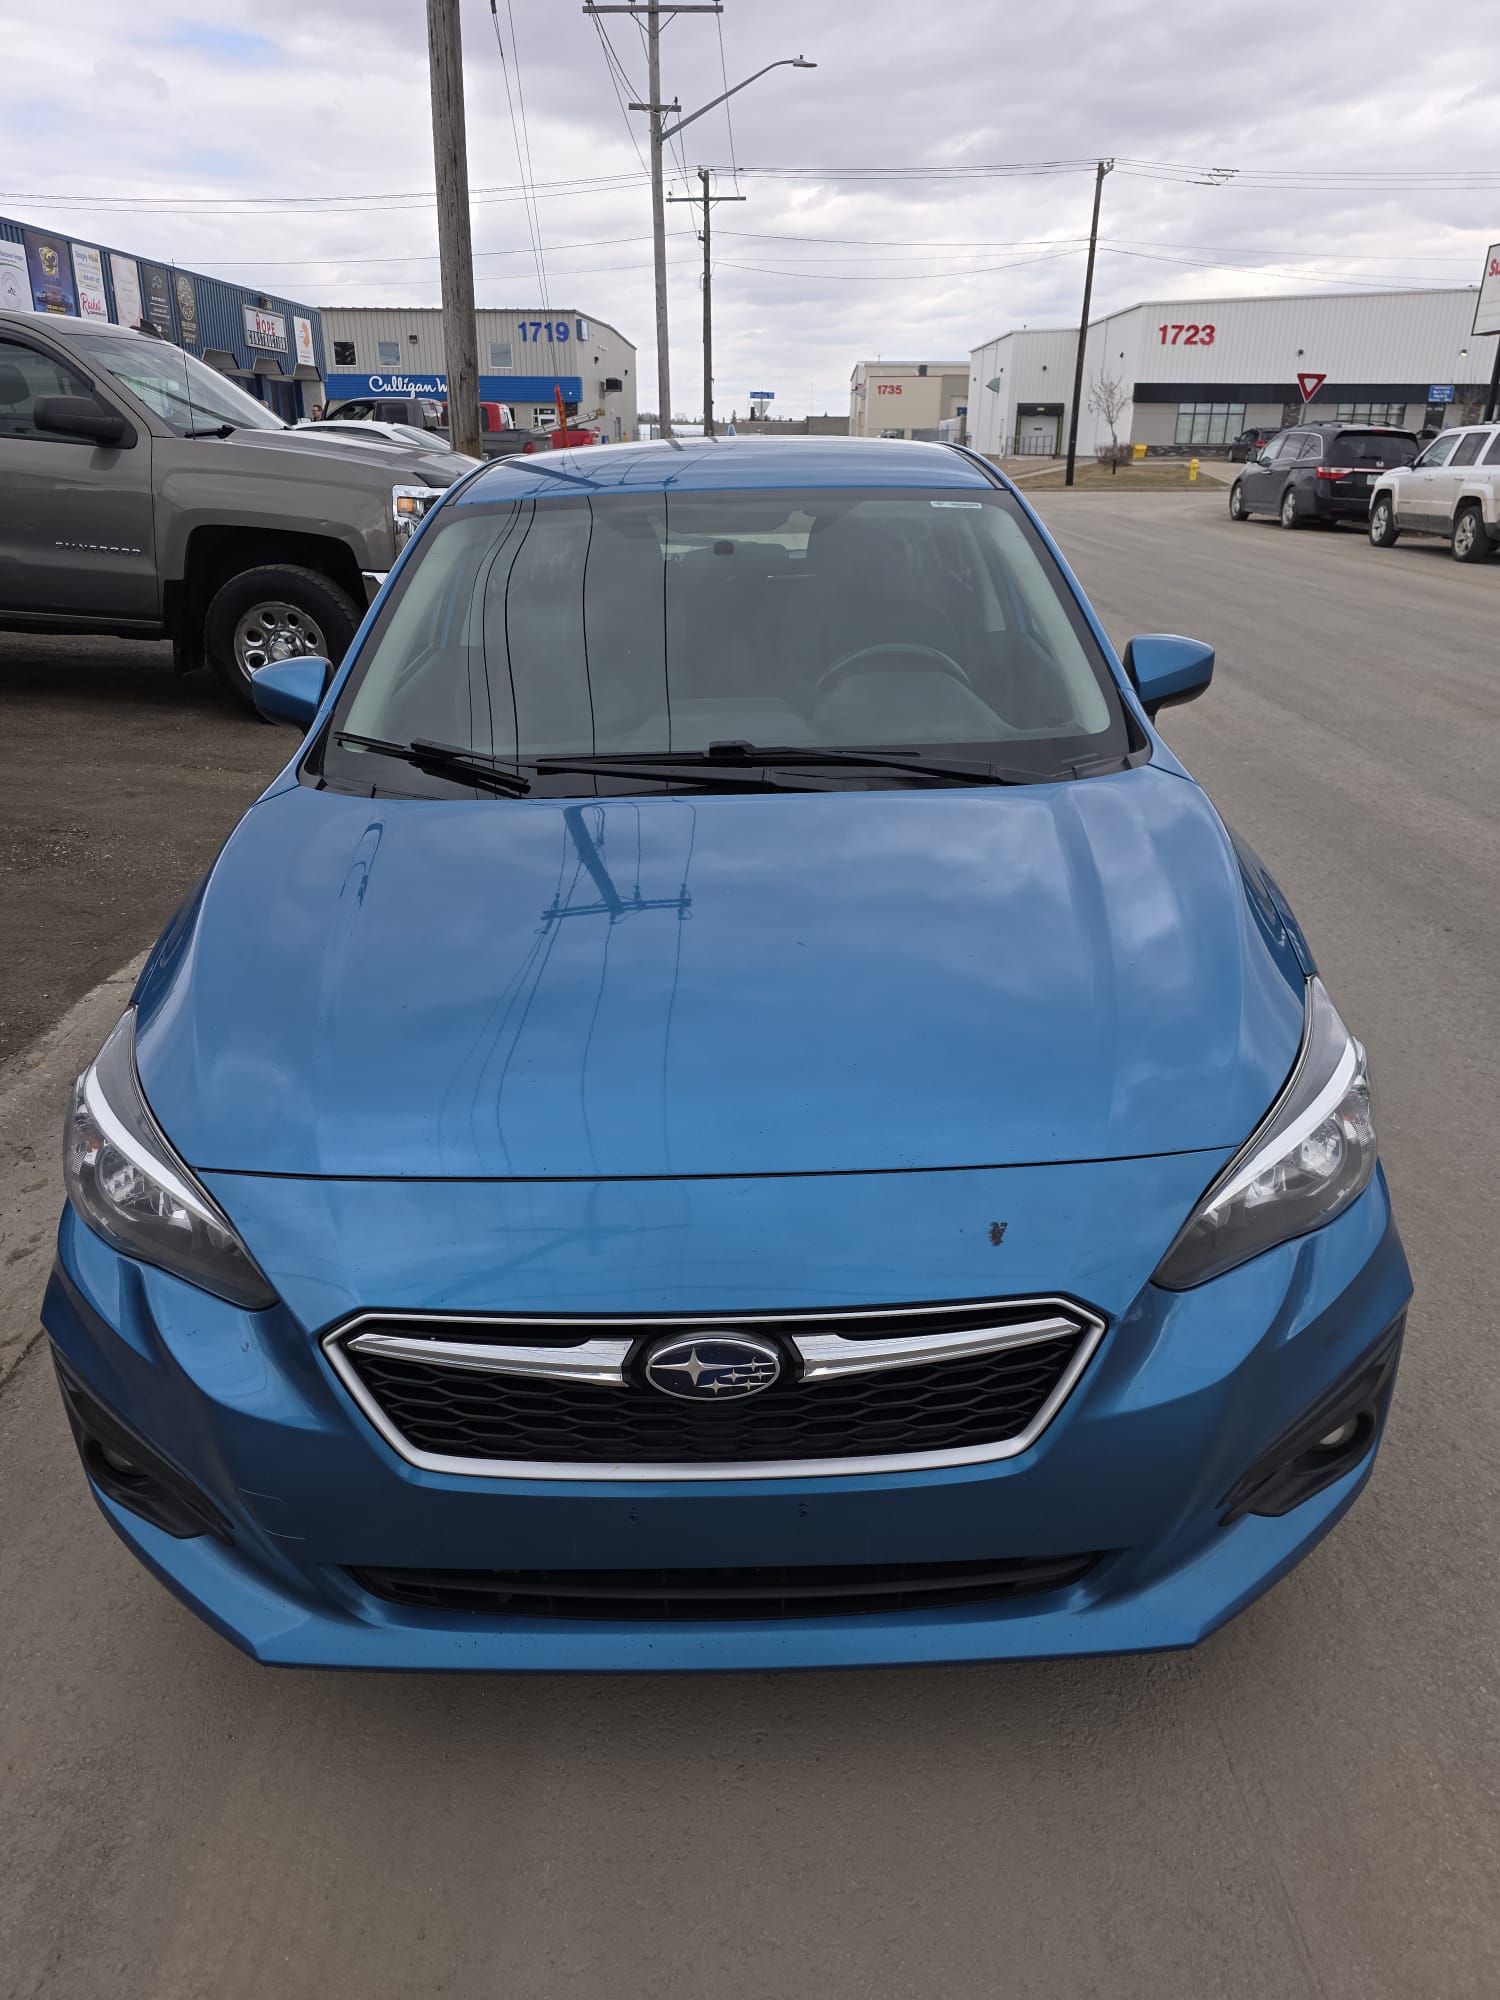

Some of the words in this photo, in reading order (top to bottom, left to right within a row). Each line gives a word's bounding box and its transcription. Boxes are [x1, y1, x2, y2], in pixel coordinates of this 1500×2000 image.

[518, 321, 570, 342] 1719
[1159, 324, 1216, 346] 1723
[368, 375, 437, 400] Culligan
[877, 384, 903, 395] 1735
